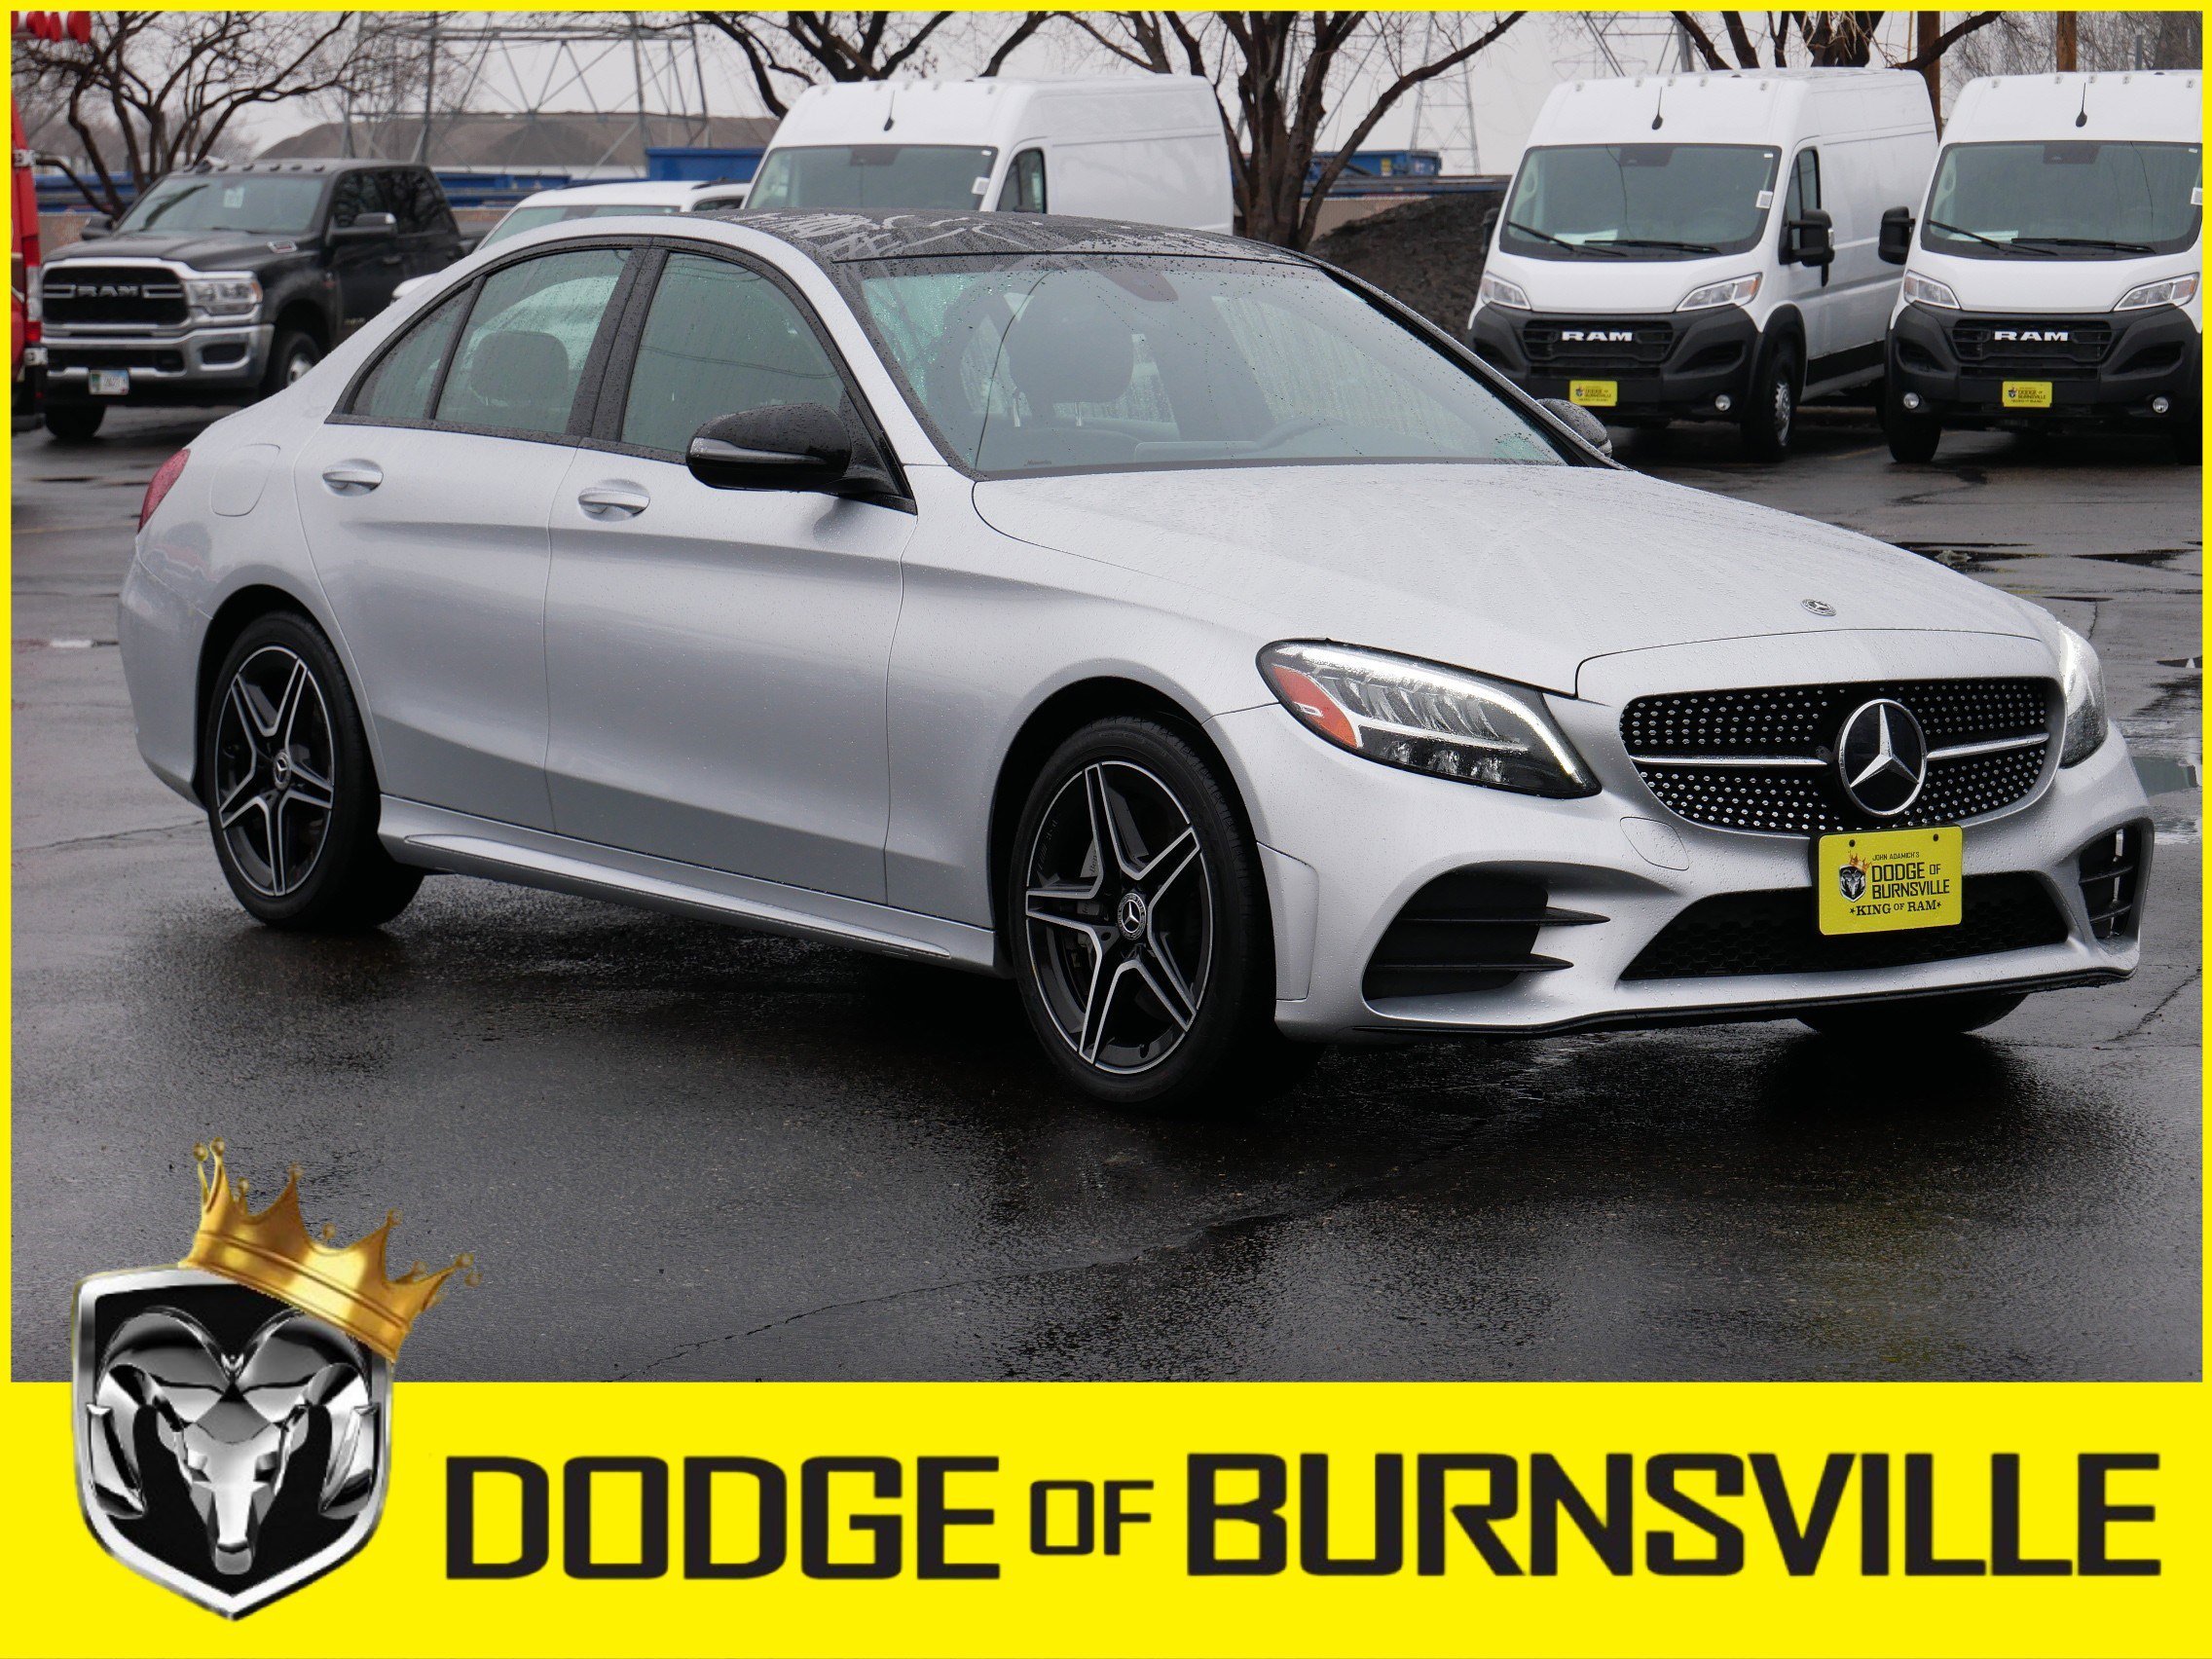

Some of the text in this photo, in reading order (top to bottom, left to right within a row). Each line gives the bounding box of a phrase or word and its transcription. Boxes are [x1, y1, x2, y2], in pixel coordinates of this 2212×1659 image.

[77, 285, 138, 297] RAM
[1561, 331, 1633, 342] RAM
[1994, 331, 2069, 342] RAM
[1889, 851, 1920, 860] ADAMICH'S
[1871, 862, 1941, 883] DODGE OF
[1871, 878, 1950, 900] BURNSVILLE
[1856, 899, 1937, 916] KING OF RAM
